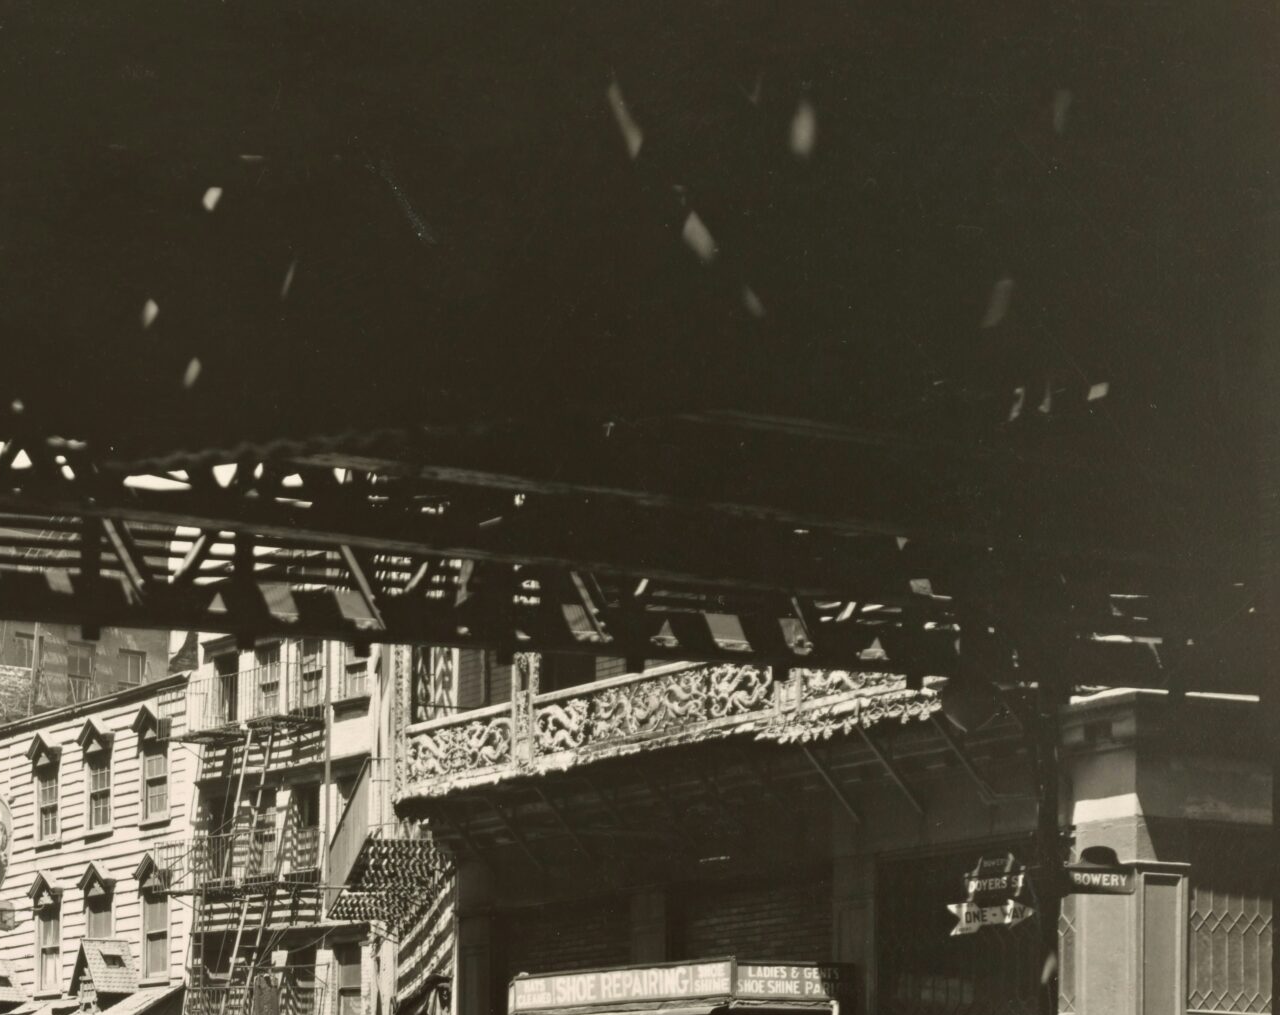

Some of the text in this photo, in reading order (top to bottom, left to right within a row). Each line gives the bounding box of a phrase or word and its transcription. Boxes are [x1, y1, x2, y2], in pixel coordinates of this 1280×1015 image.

[1073, 872, 1128, 887] BOWERY
[697, 963, 726, 979] SHOE
[747, 966, 839, 980] LADIES & GENTS
[556, 965, 689, 1002] SHOE REPAIRING
[694, 978, 730, 995] SHINE
[737, 979, 765, 994] SHOE
[767, 980, 801, 995] SHINE
